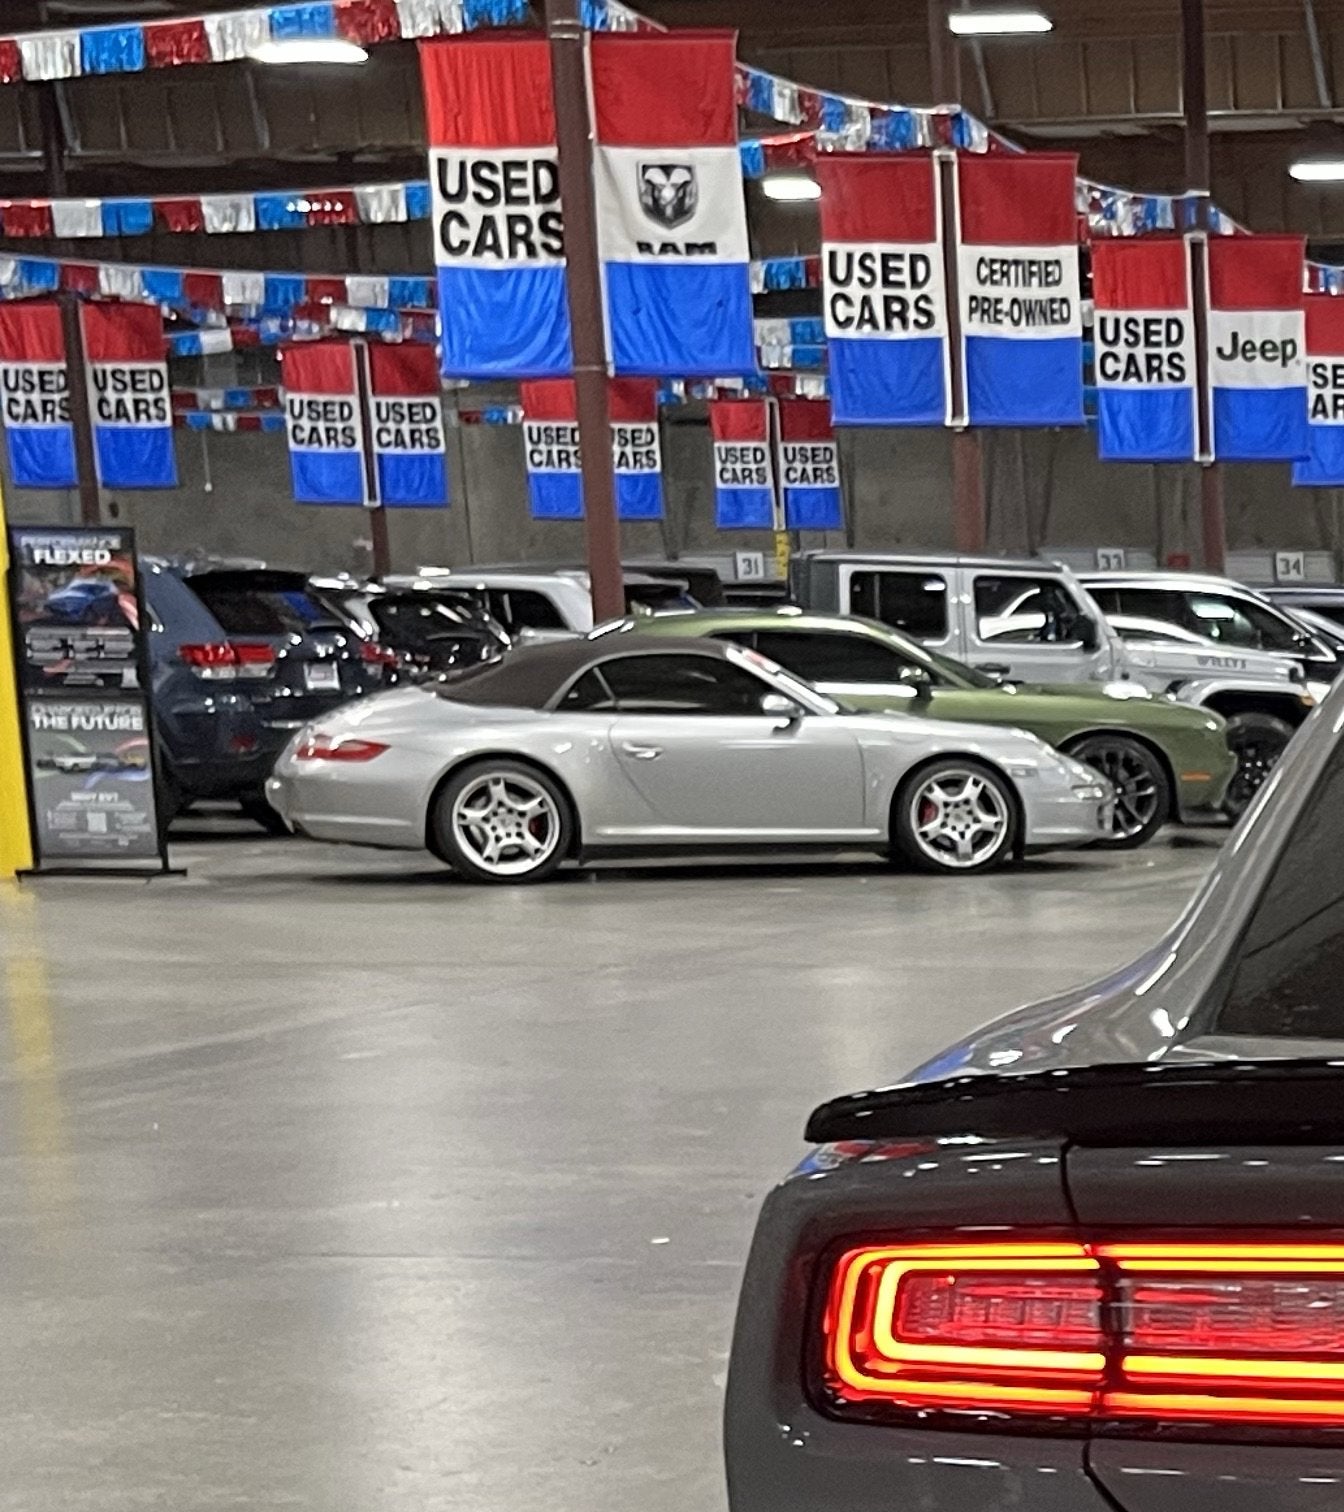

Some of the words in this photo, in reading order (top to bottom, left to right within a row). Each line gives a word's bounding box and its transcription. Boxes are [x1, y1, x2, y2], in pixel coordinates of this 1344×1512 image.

[437, 157, 560, 208] USED
[440, 210, 564, 260] CARS
[637, 241, 718, 256] RAM
[828, 251, 931, 290] USED
[976, 256, 1063, 288] CERTIFIED
[830, 292, 936, 330] CARS
[968, 294, 1071, 327] PRE-OWNED
[1100, 317, 1184, 348] USED
[1216, 331, 1298, 368] Jeep
[1100, 351, 1186, 383] CARS
[3, 368, 68, 394] USED
[93, 368, 164, 394] USED
[7, 397, 70, 423] CARS
[97, 397, 167, 423] CARS
[289, 399, 353, 423] USED
[376, 401, 437, 425] USED
[292, 425, 356, 448] CARS
[376, 426, 441, 449] CARS
[612, 427, 656, 447] SED
[616, 450, 658, 470] ARS
[718, 446, 765, 465] USED
[784, 446, 834, 465] USED
[720, 467, 767, 485] CARS
[785, 466, 836, 485] CARS
[34, 550, 112, 565] FLEXED
[741, 558, 759, 575] 31
[33, 716, 69, 730] THE
[71, 716, 144, 731] FUTURE
